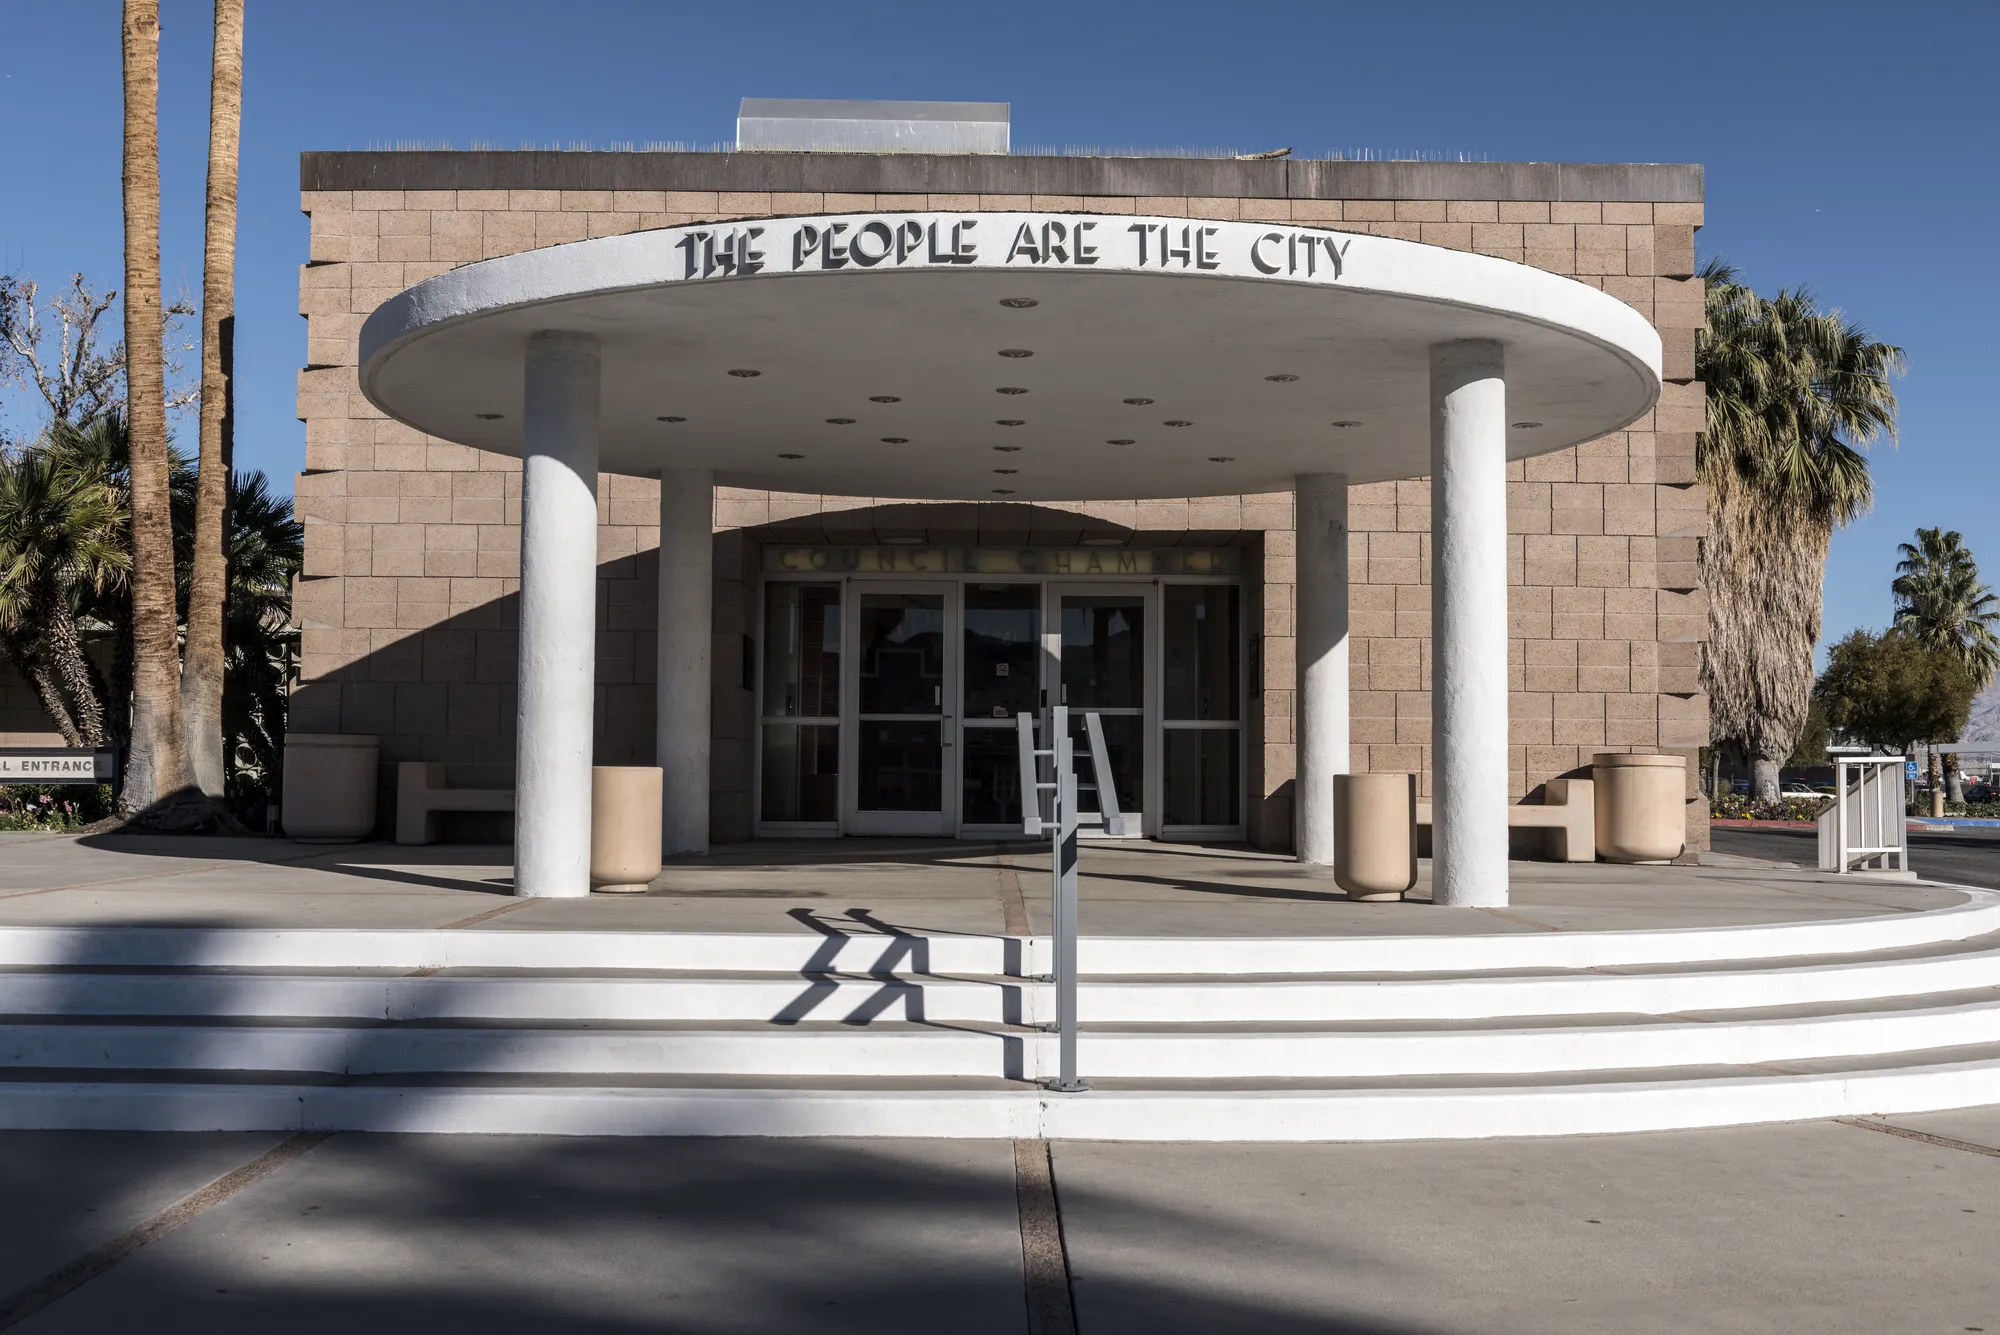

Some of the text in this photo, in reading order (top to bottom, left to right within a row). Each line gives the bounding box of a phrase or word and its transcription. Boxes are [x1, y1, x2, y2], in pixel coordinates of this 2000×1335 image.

[676, 218, 1351, 281] THE PEOPLE ARE THE CITY
[780, 548, 978, 572] COUNCIL
[21, 760, 103, 772] ENTRANCE
